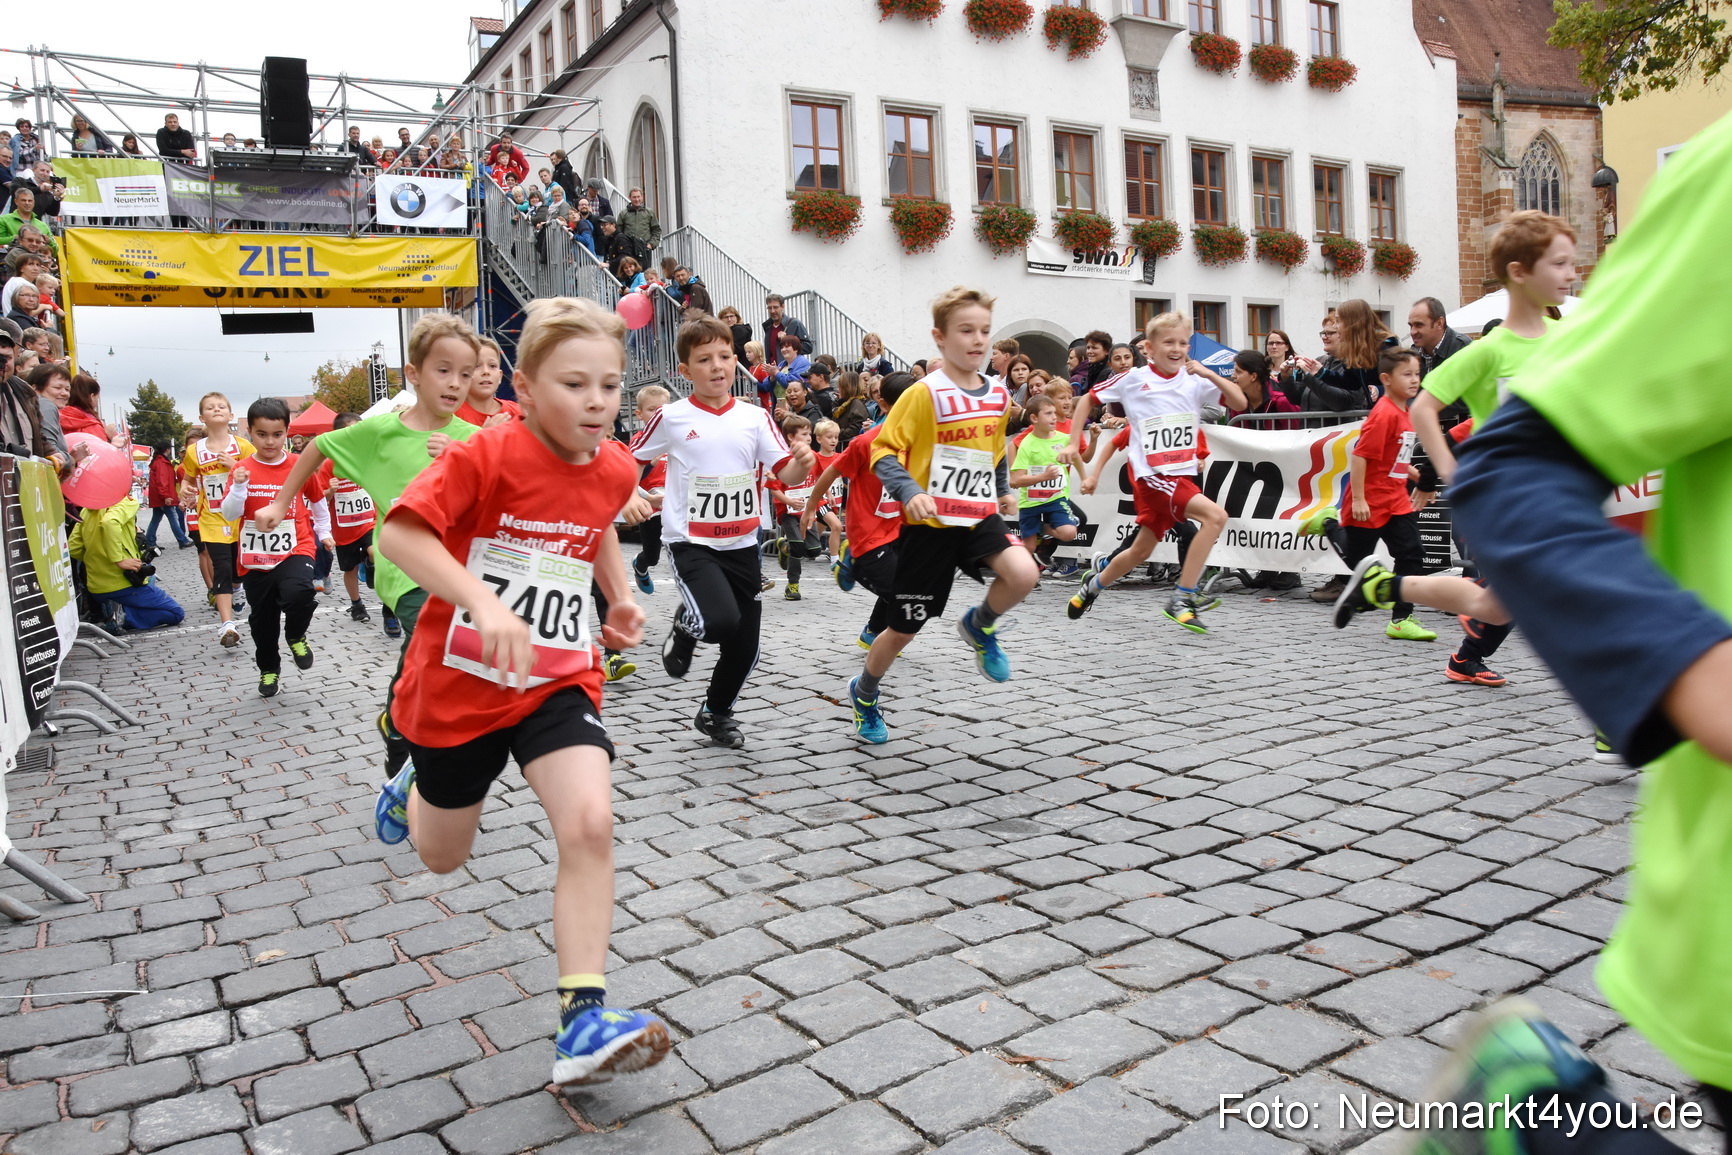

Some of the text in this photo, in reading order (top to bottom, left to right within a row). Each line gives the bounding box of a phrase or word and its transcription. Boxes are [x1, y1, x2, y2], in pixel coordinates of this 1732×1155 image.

[171, 179, 241, 196] BOCK
[247, 185, 279, 194] OFFICE
[281, 187, 328, 196] INDUSTRY
[393, 183, 424, 197] BMW
[113, 196, 160, 204] NeuerMarkt
[265, 198, 349, 209] www.bockonline.de
[91, 258, 186, 270] Neumarkter Stadtlauf
[238, 245, 330, 277] ZIEL
[1072, 248, 1119, 267] swn
[377, 263, 459, 272] Neumarkter Stadtlauf
[1071, 265, 1103, 274] stadtwerke
[1103, 267, 1130, 275] neumarkt
[143, 284, 179, 292] Stadtlauf
[937, 424, 979, 443] MAX
[1147, 426, 1193, 450] 7025
[200, 463, 220, 473] MAX
[941, 465, 992, 498] 7023
[338, 496, 371, 514] 7196
[696, 488, 754, 519] 7019
[498, 512, 590, 537] Neumarkter
[714, 525, 740, 537] Dario
[246, 532, 292, 552] 7123
[494, 530, 570, 555] Stadtlauf
[482, 553, 531, 571] NeuerMarkt
[540, 557, 589, 582] BOCK
[482, 573, 582, 643] 7403
[901, 603, 927, 621] 13
[20, 615, 41, 630] Freizeit
[26, 647, 57, 666] Stadtbusse
